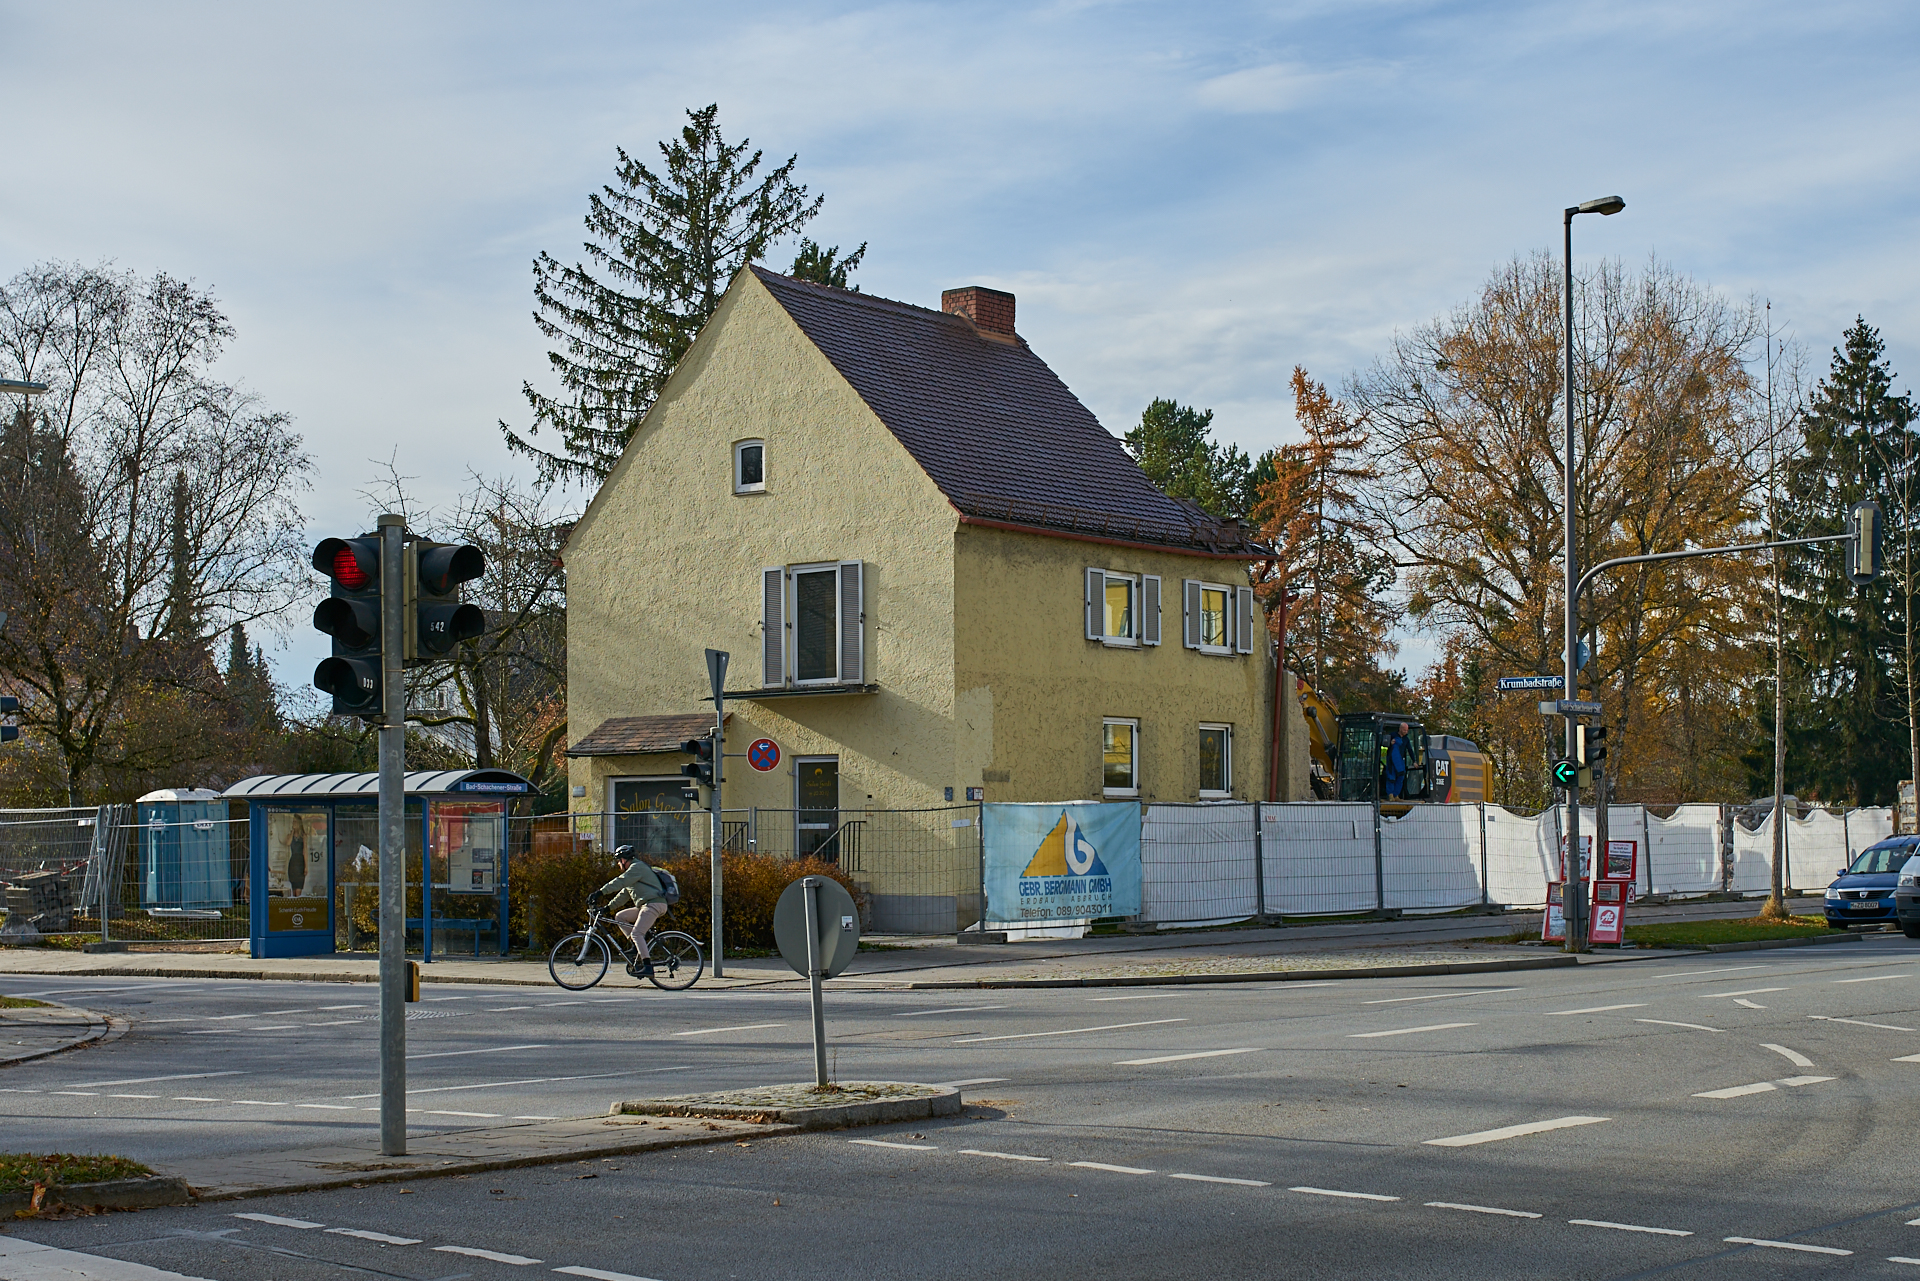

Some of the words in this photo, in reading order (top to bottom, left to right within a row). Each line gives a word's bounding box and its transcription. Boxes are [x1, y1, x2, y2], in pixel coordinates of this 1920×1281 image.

[430, 621, 444, 632] 542
[1500, 677, 1563, 690] Krumbadstraße
[1435, 759, 1449, 777] CAT
[465, 783, 523, 792] Bad-Schachener-Straße
[619, 792, 651, 821] Salon
[1019, 880, 1044, 897] GEBR.
[1044, 878, 1087, 896] BERGMANN
[1088, 877, 1112, 893] GMBH
[1020, 896, 1056, 906] ERDBAU
[1070, 893, 1113, 903] ABBRUCH
[1020, 907, 1054, 918] Telefon:
[1056, 903, 1113, 917] 089/9043011
